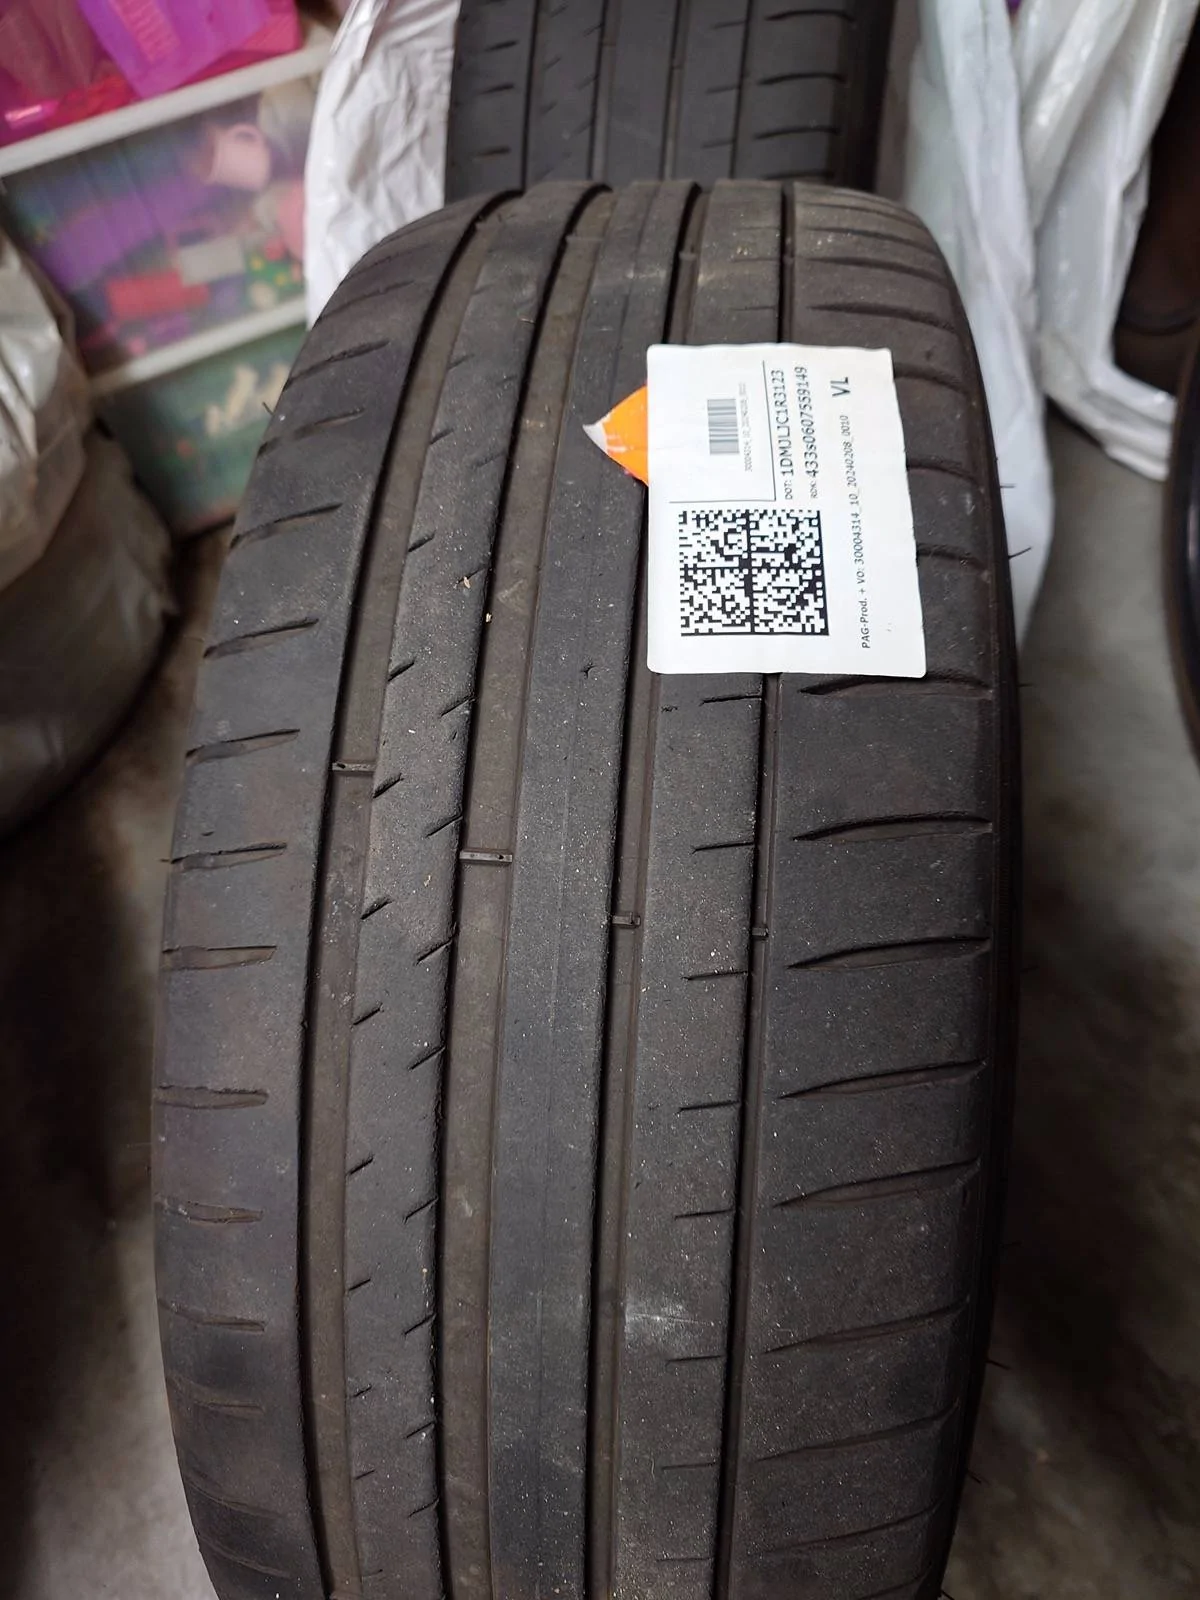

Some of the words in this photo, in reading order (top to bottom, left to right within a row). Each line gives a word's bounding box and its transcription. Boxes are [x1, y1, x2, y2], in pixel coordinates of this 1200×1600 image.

[770, 370, 794, 477] 1DMJLJC1R3123
[794, 366, 819, 478] 433s0607559149
[830, 376, 850, 397] VL
[783, 480, 793, 500] DOT:
[839, 415, 864, 565] 30004314_10_20240208_0010
[858, 597, 870, 649] PAG-Prod.
